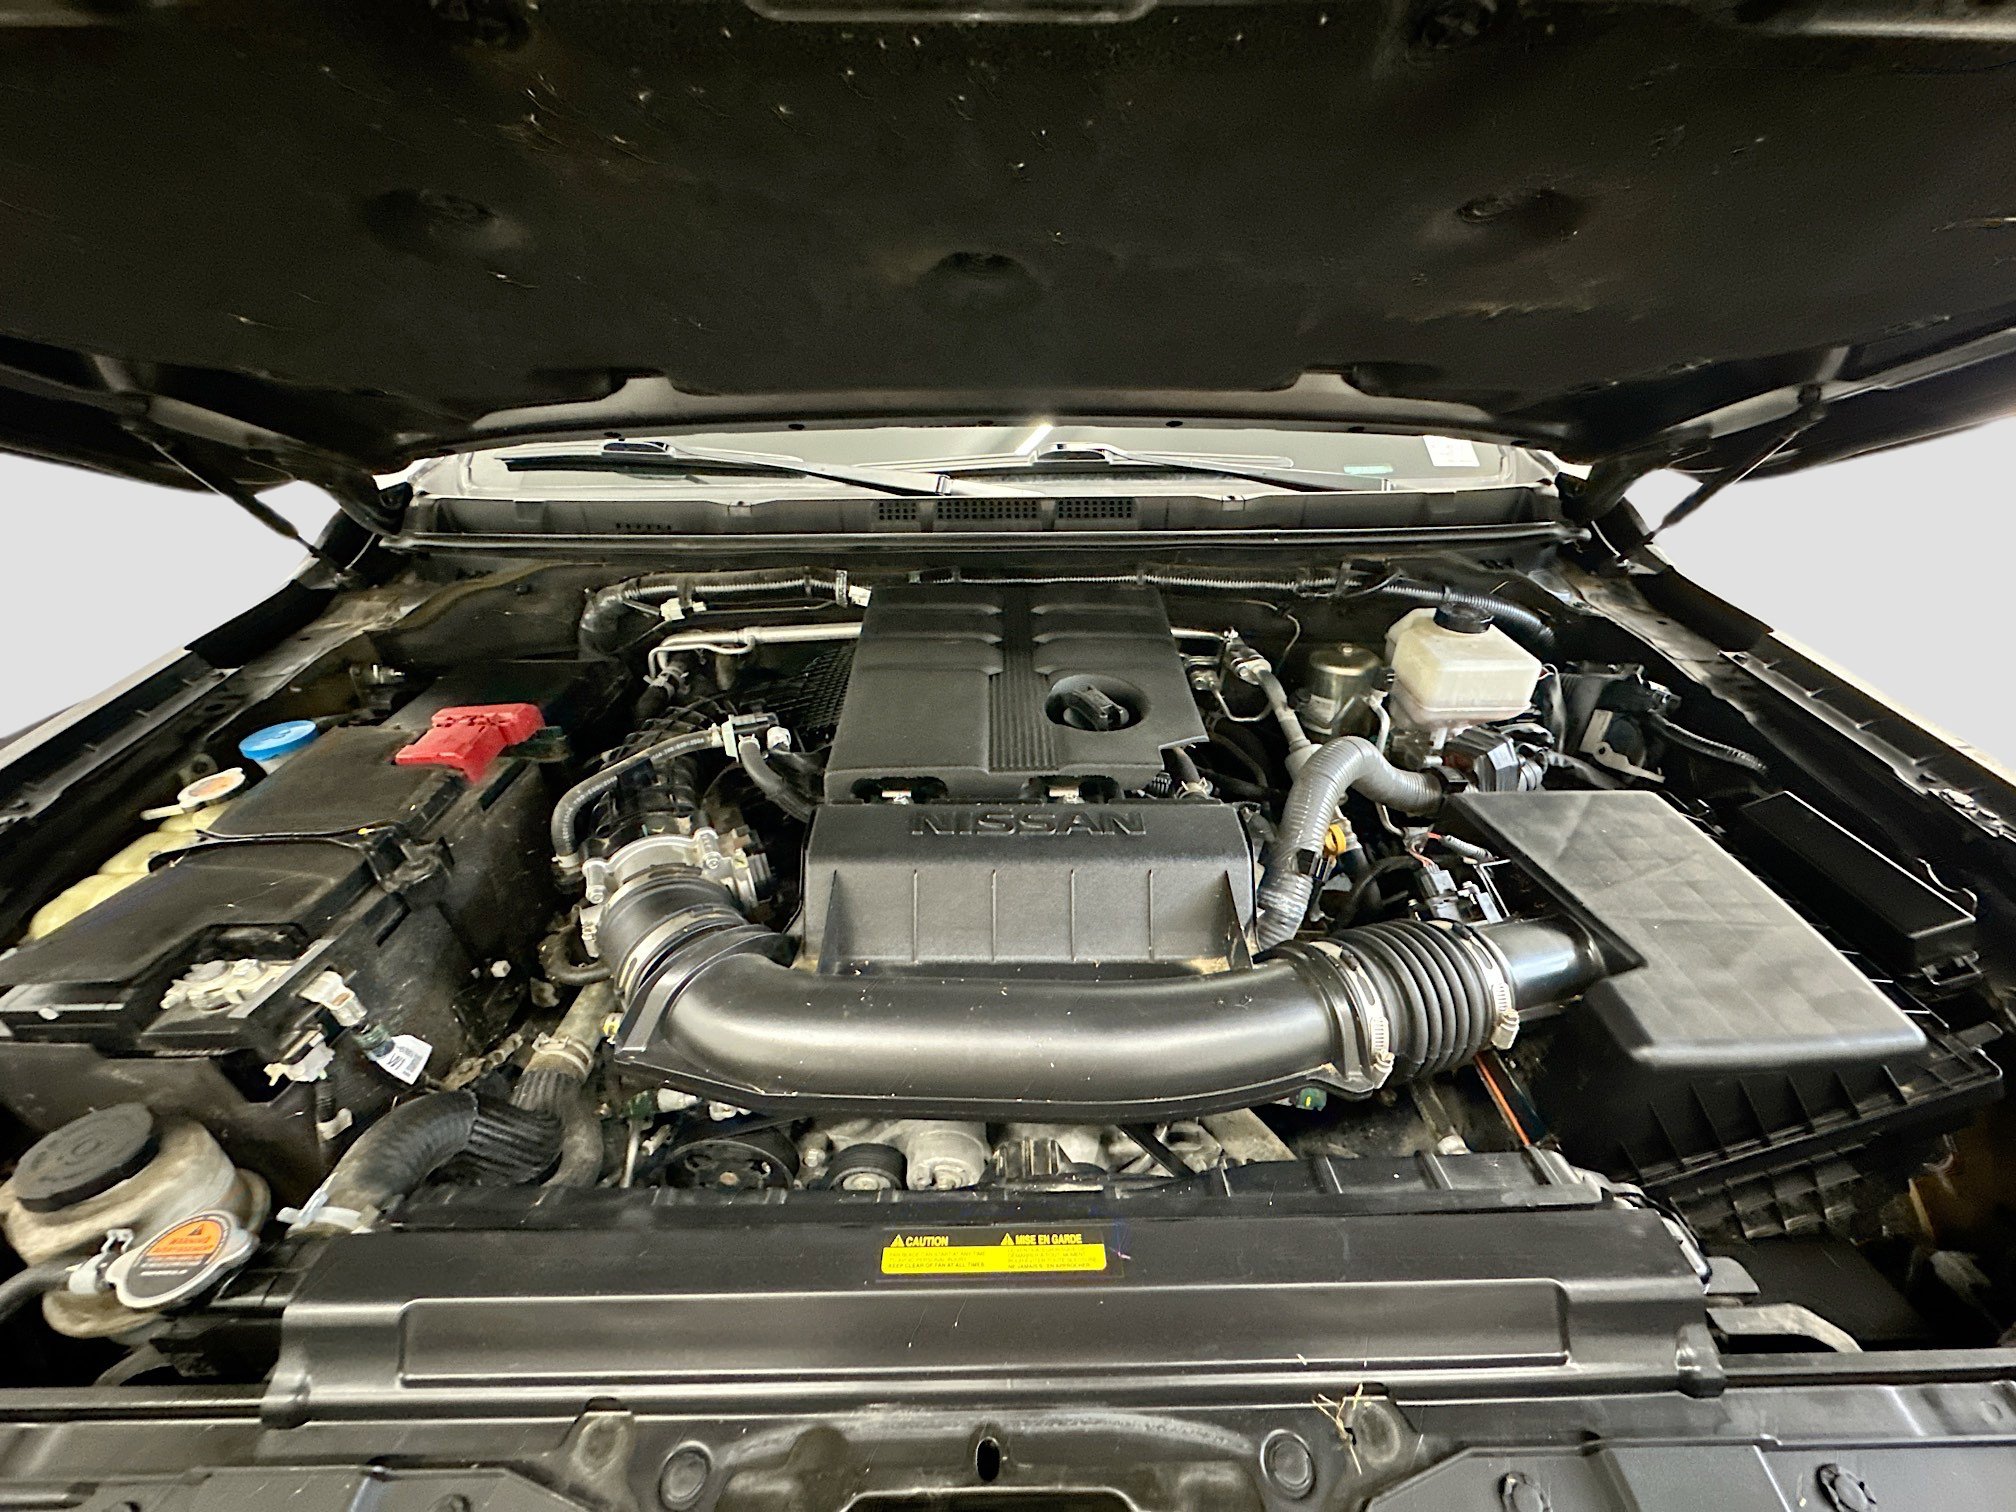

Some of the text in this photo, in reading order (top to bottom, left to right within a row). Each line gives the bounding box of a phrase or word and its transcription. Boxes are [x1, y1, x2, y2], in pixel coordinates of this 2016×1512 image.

[911, 811, 1147, 835] NISSAN
[905, 1235, 949, 1247] CAUTION
[1015, 1233, 1083, 1245] MISE EN GARDE
